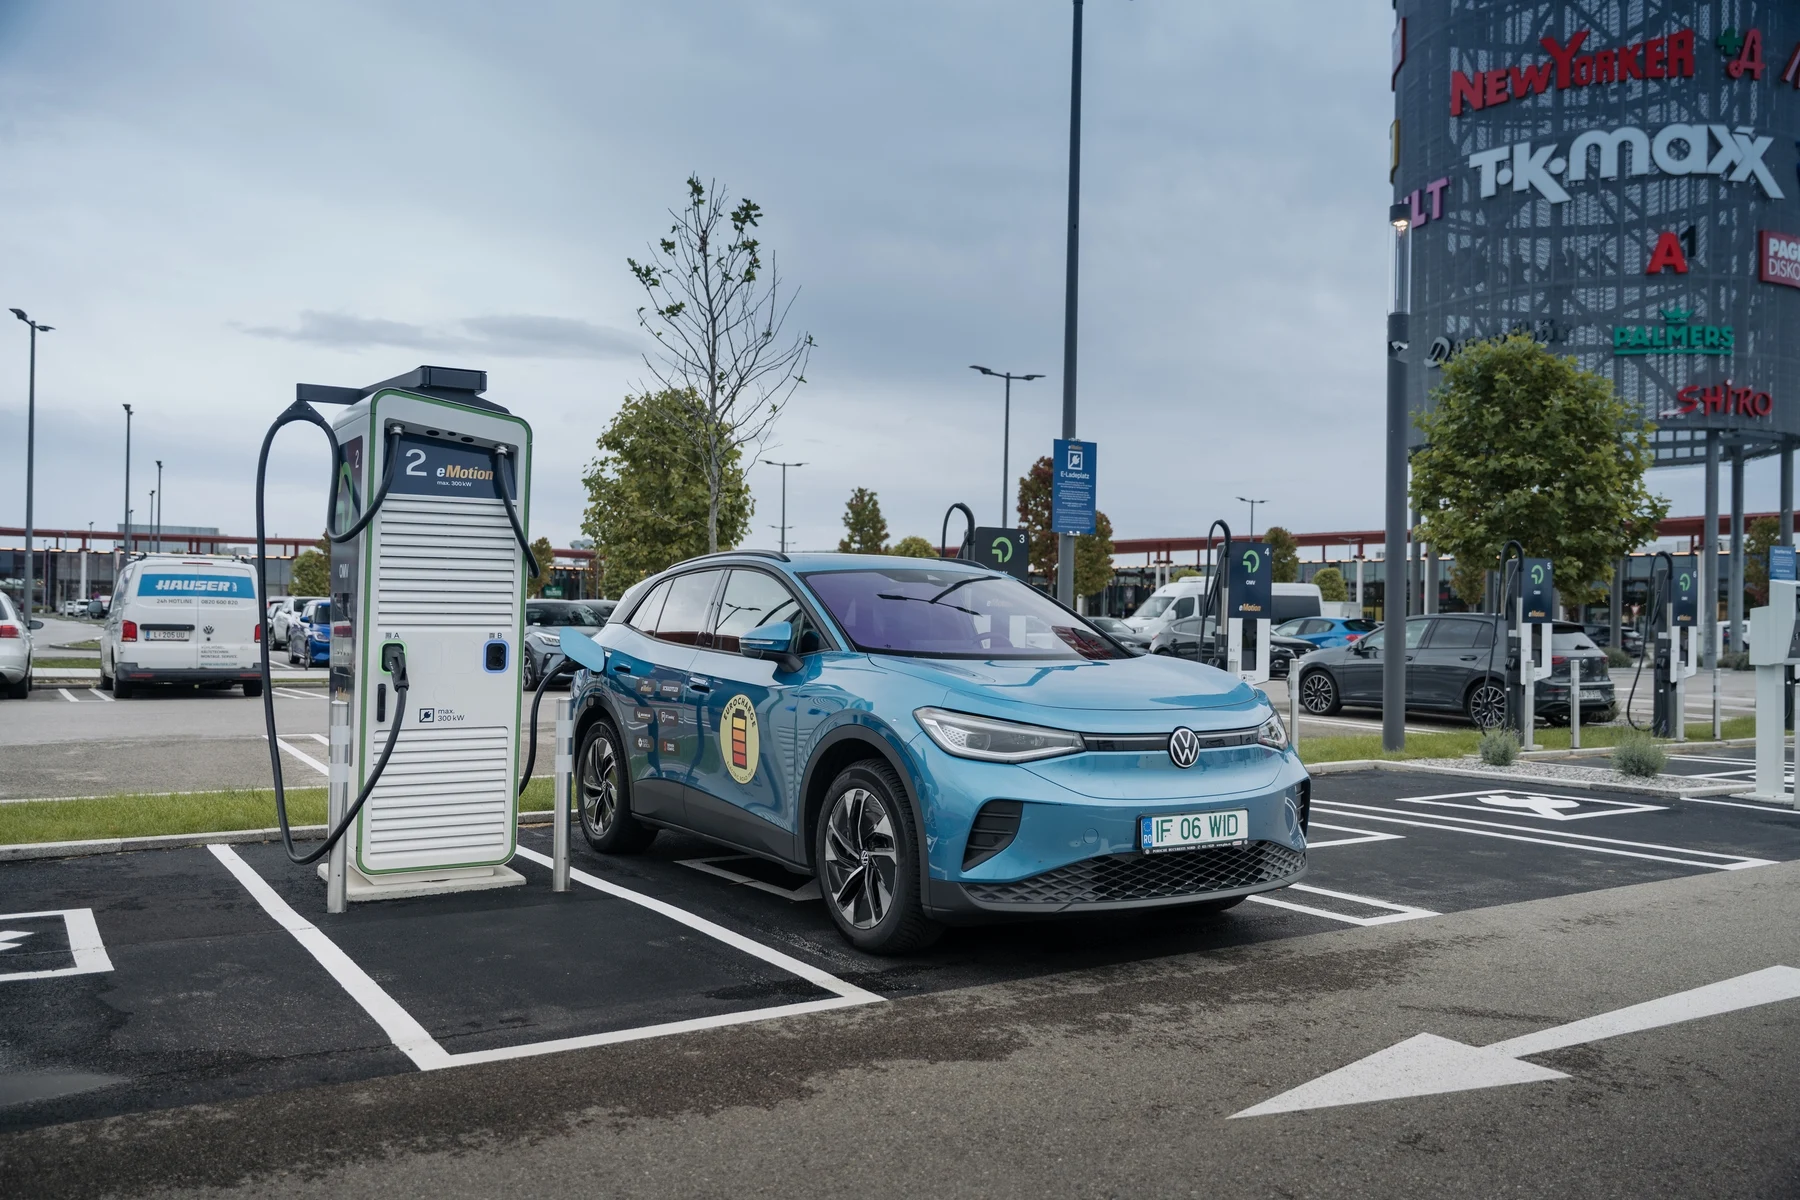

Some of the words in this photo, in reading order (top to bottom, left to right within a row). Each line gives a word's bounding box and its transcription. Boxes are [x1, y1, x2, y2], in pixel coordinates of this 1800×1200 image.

[1646, 226, 1696, 274] A1
[1614, 326, 1735, 348] PALMERS
[354, 450, 360, 468] 2
[405, 448, 428, 476] 2
[436, 464, 494, 480] eMotion
[1060, 470, 1090, 480] E-Ladeplatz
[1019, 534, 1025, 544] 3
[1264, 547, 1270, 556] 4
[1546, 562, 1552, 570] 5
[156, 580, 230, 591] HAUSER
[723, 697, 756, 728] EUROCHARGE
[1155, 818, 1173, 843] IF
[1180, 817, 1202, 840] 06
[1208, 814, 1238, 838] WID
[1143, 834, 1152, 844] RO
